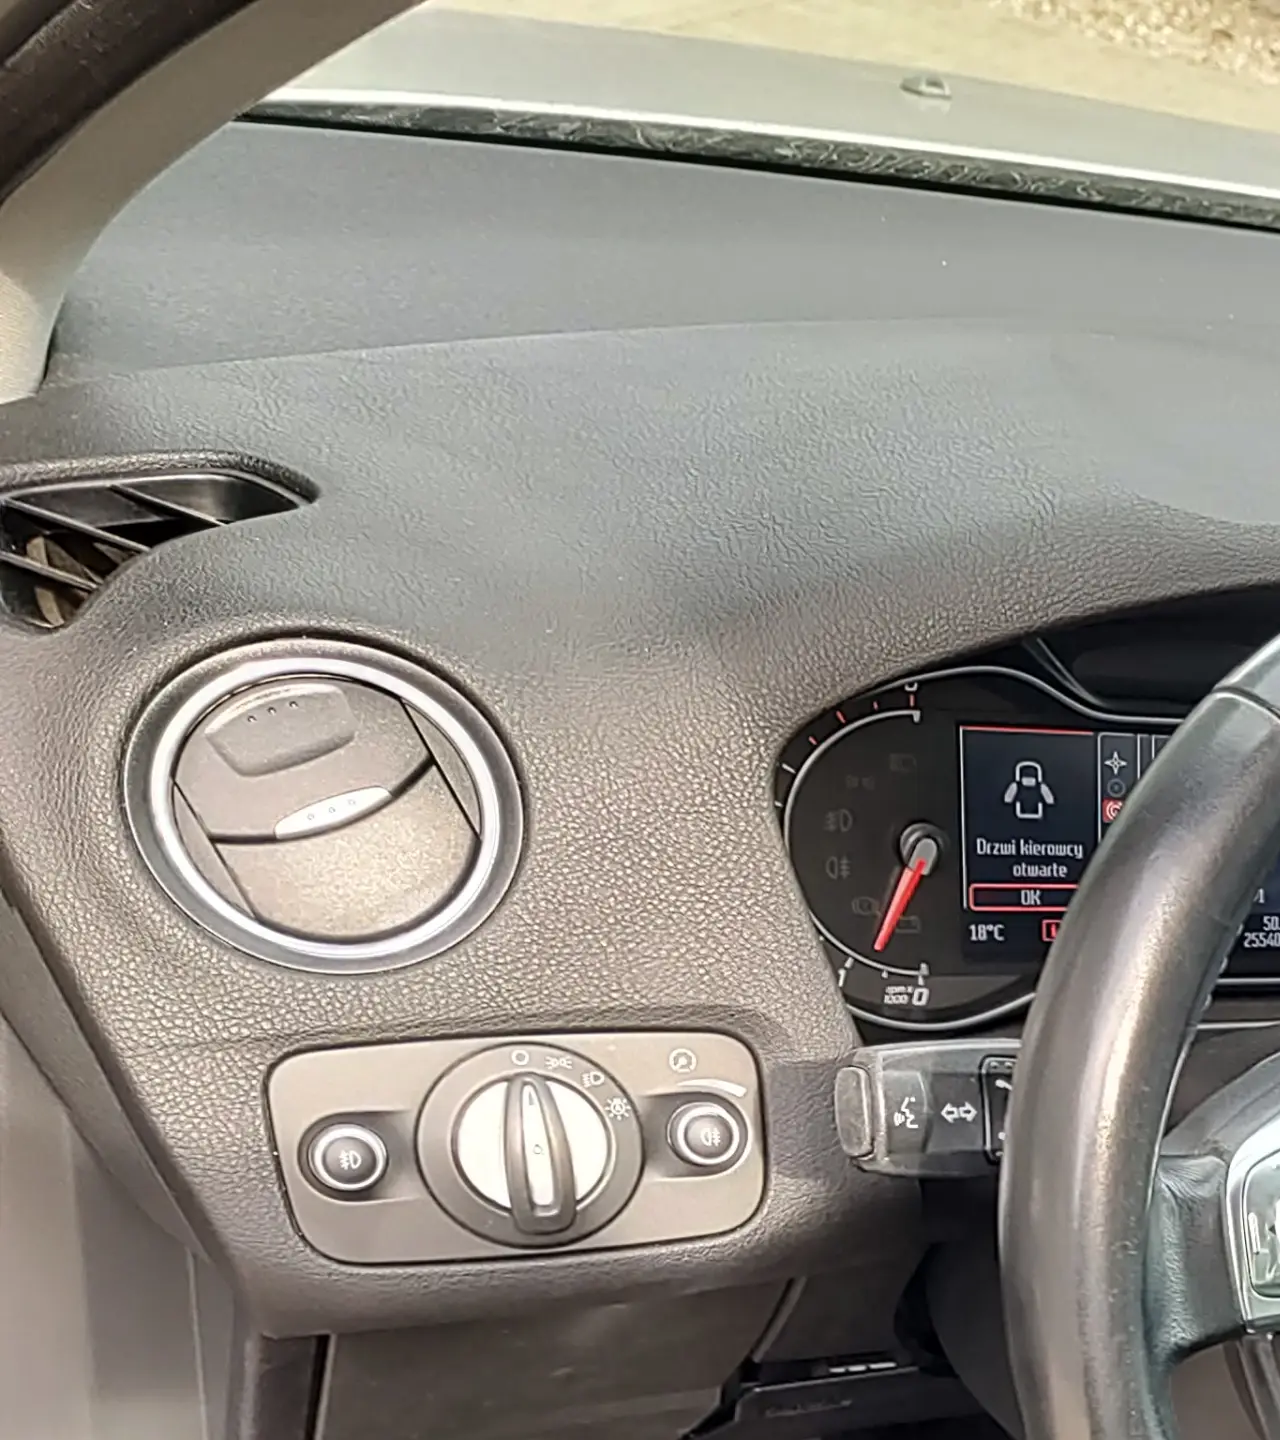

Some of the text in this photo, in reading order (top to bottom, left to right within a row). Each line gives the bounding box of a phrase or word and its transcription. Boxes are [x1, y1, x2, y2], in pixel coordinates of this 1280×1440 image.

[976, 837, 1084, 860] Drzwi kierowcy
[1012, 861, 1069, 878] otwarte
[1020, 889, 1042, 906] OK
[968, 923, 1006, 942] 18°C
[837, 968, 847, 988] 1
[911, 986, 930, 1006] 0
